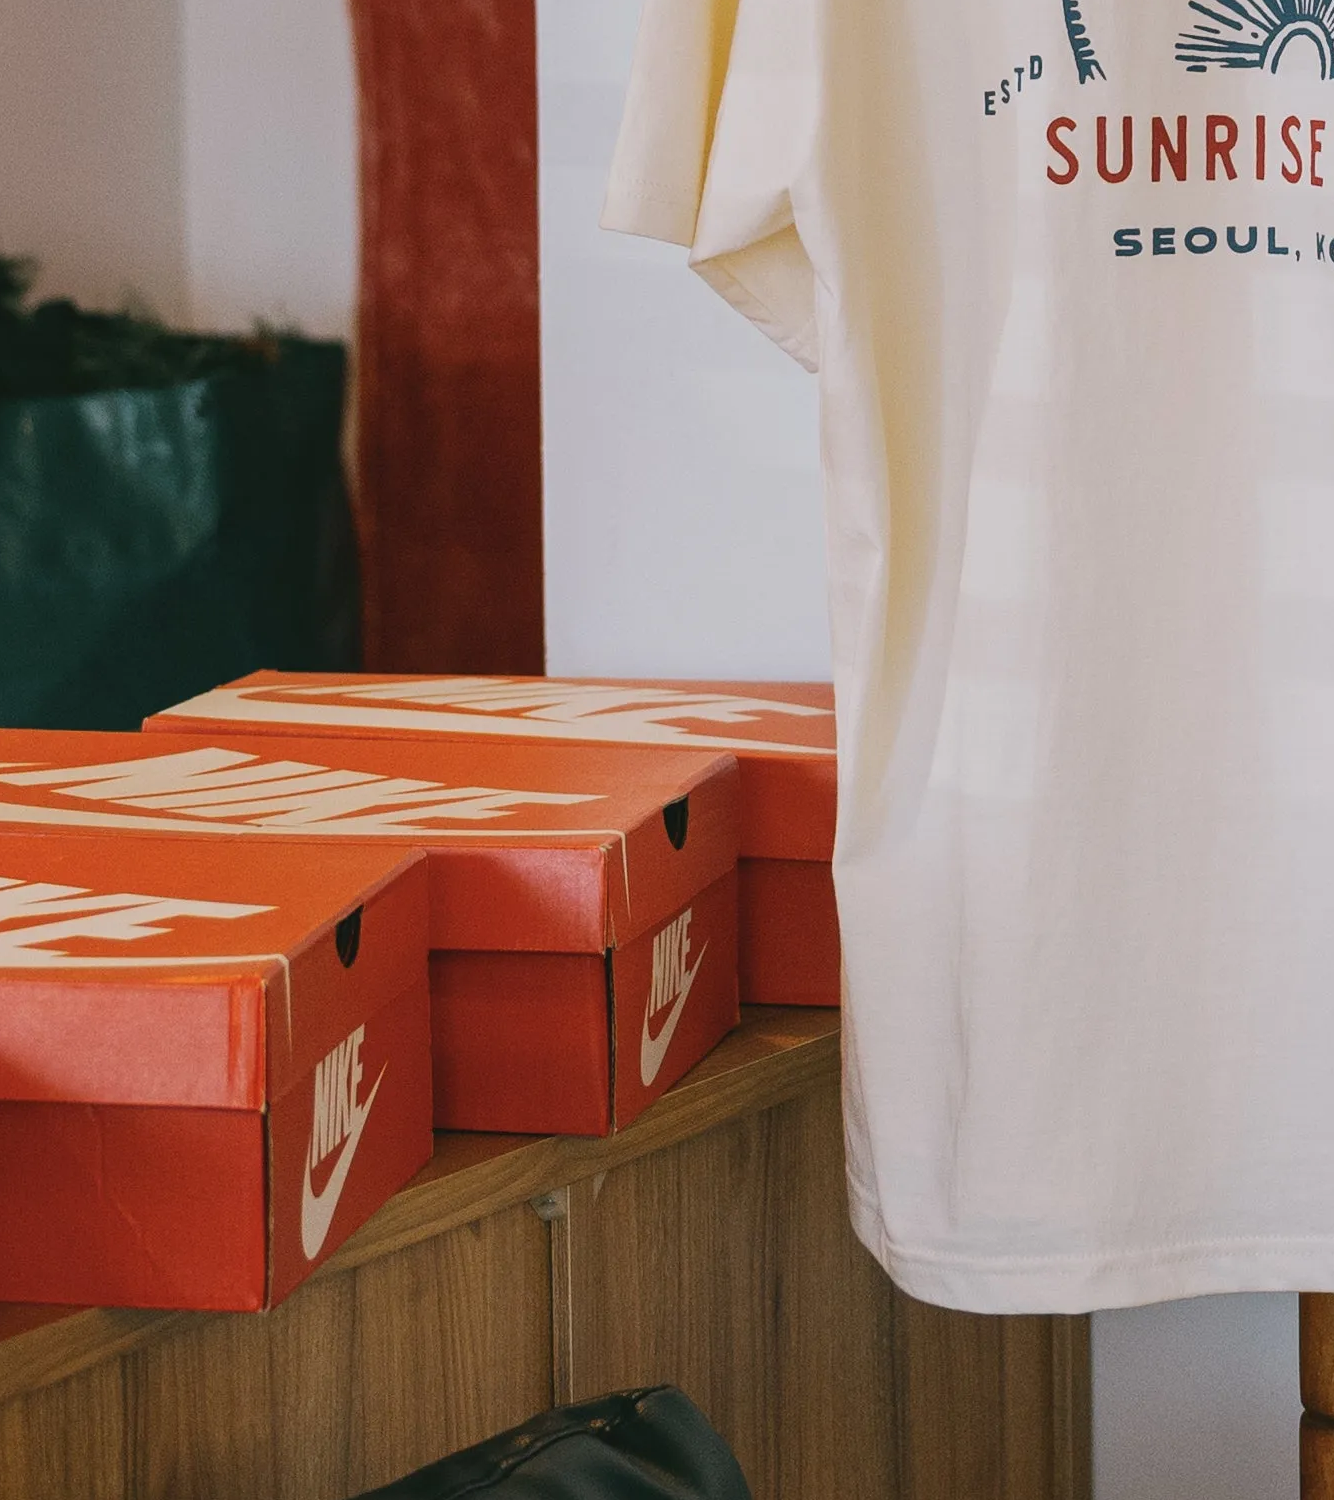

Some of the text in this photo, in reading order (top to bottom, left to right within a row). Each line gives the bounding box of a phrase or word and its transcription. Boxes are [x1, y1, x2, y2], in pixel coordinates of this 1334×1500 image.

[984, 55, 1043, 116] ESTD
[1046, 114, 1326, 186] SUNRISE
[1113, 226, 1301, 262] SEOUL,
[286, 677, 834, 737] NIKE
[648, 906, 694, 1019] NIKE
[310, 1021, 366, 1170] NIKE
